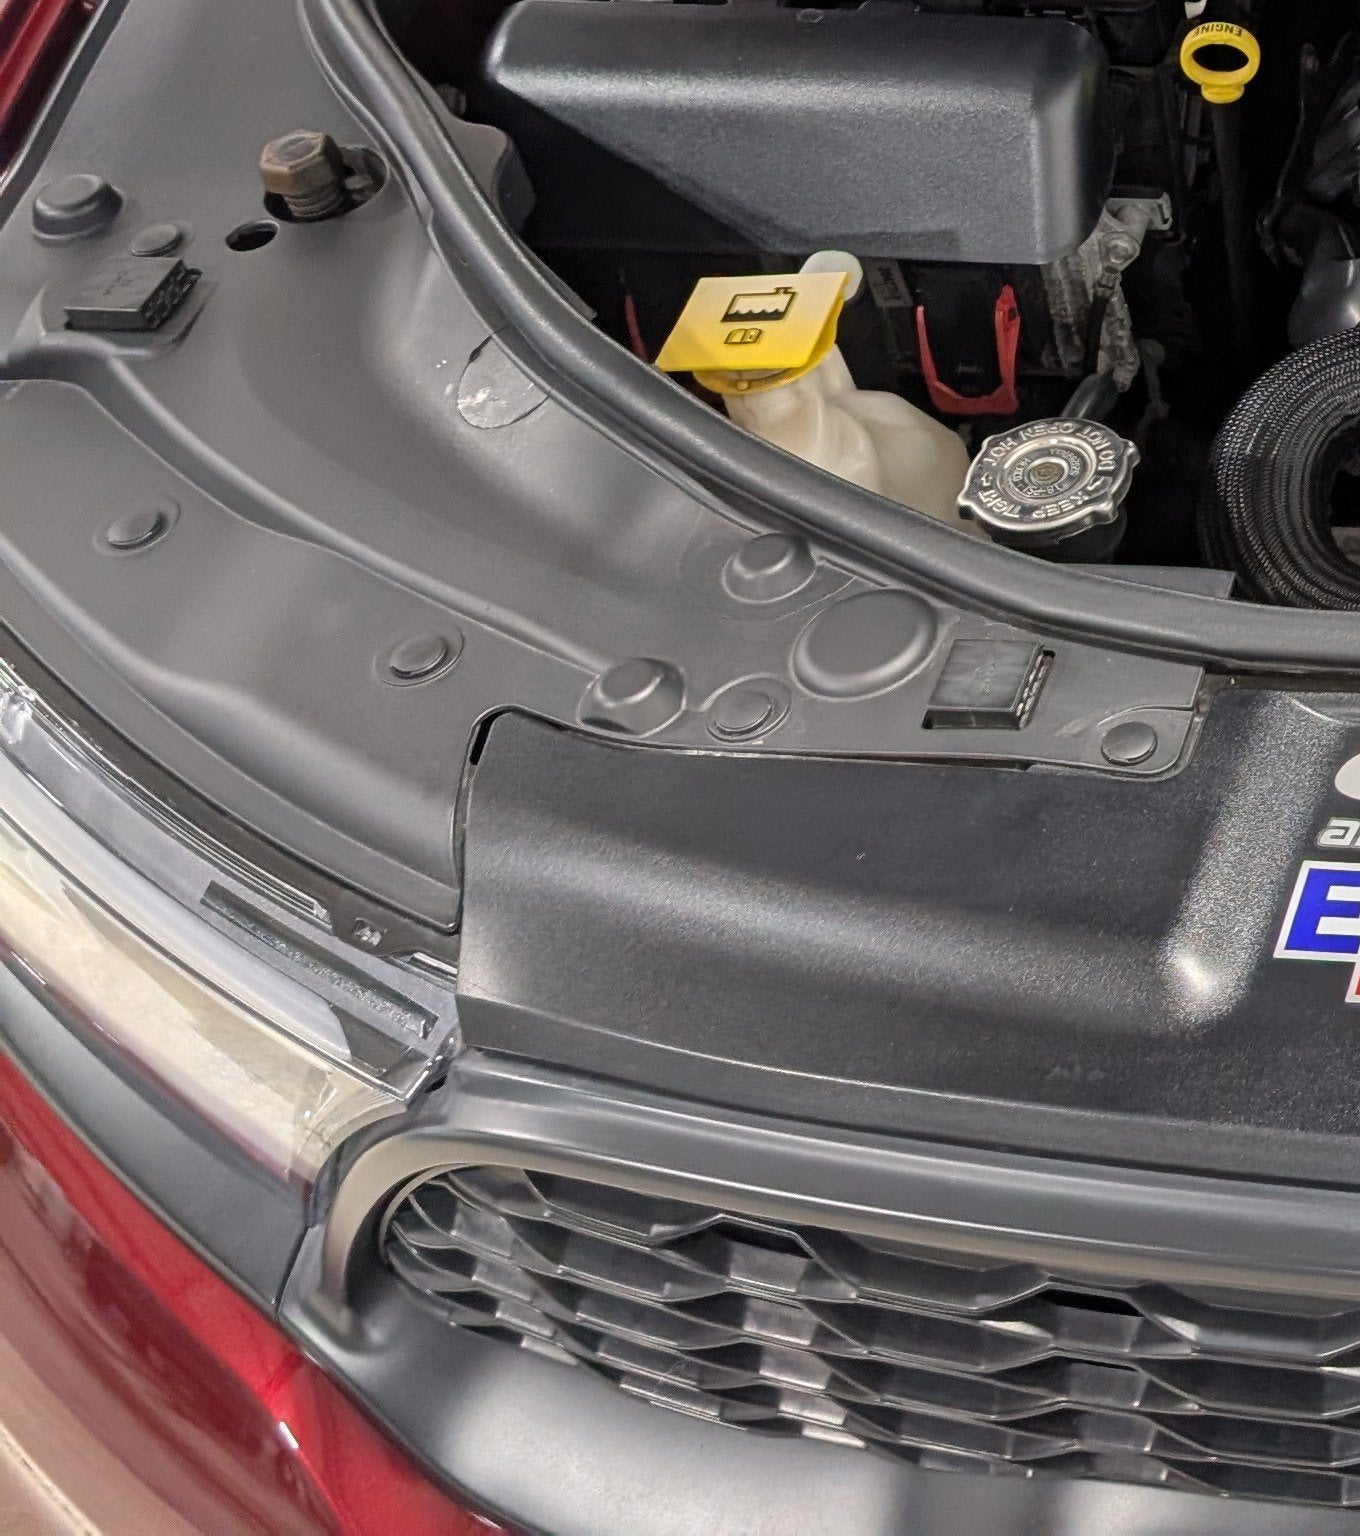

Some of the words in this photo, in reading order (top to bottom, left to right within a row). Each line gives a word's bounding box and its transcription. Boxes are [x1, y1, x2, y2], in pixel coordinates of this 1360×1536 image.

[1193, 24, 1243, 37] ENGINE
[978, 489, 1021, 518] TIGHT
[1032, 491, 1089, 519] KEEP
